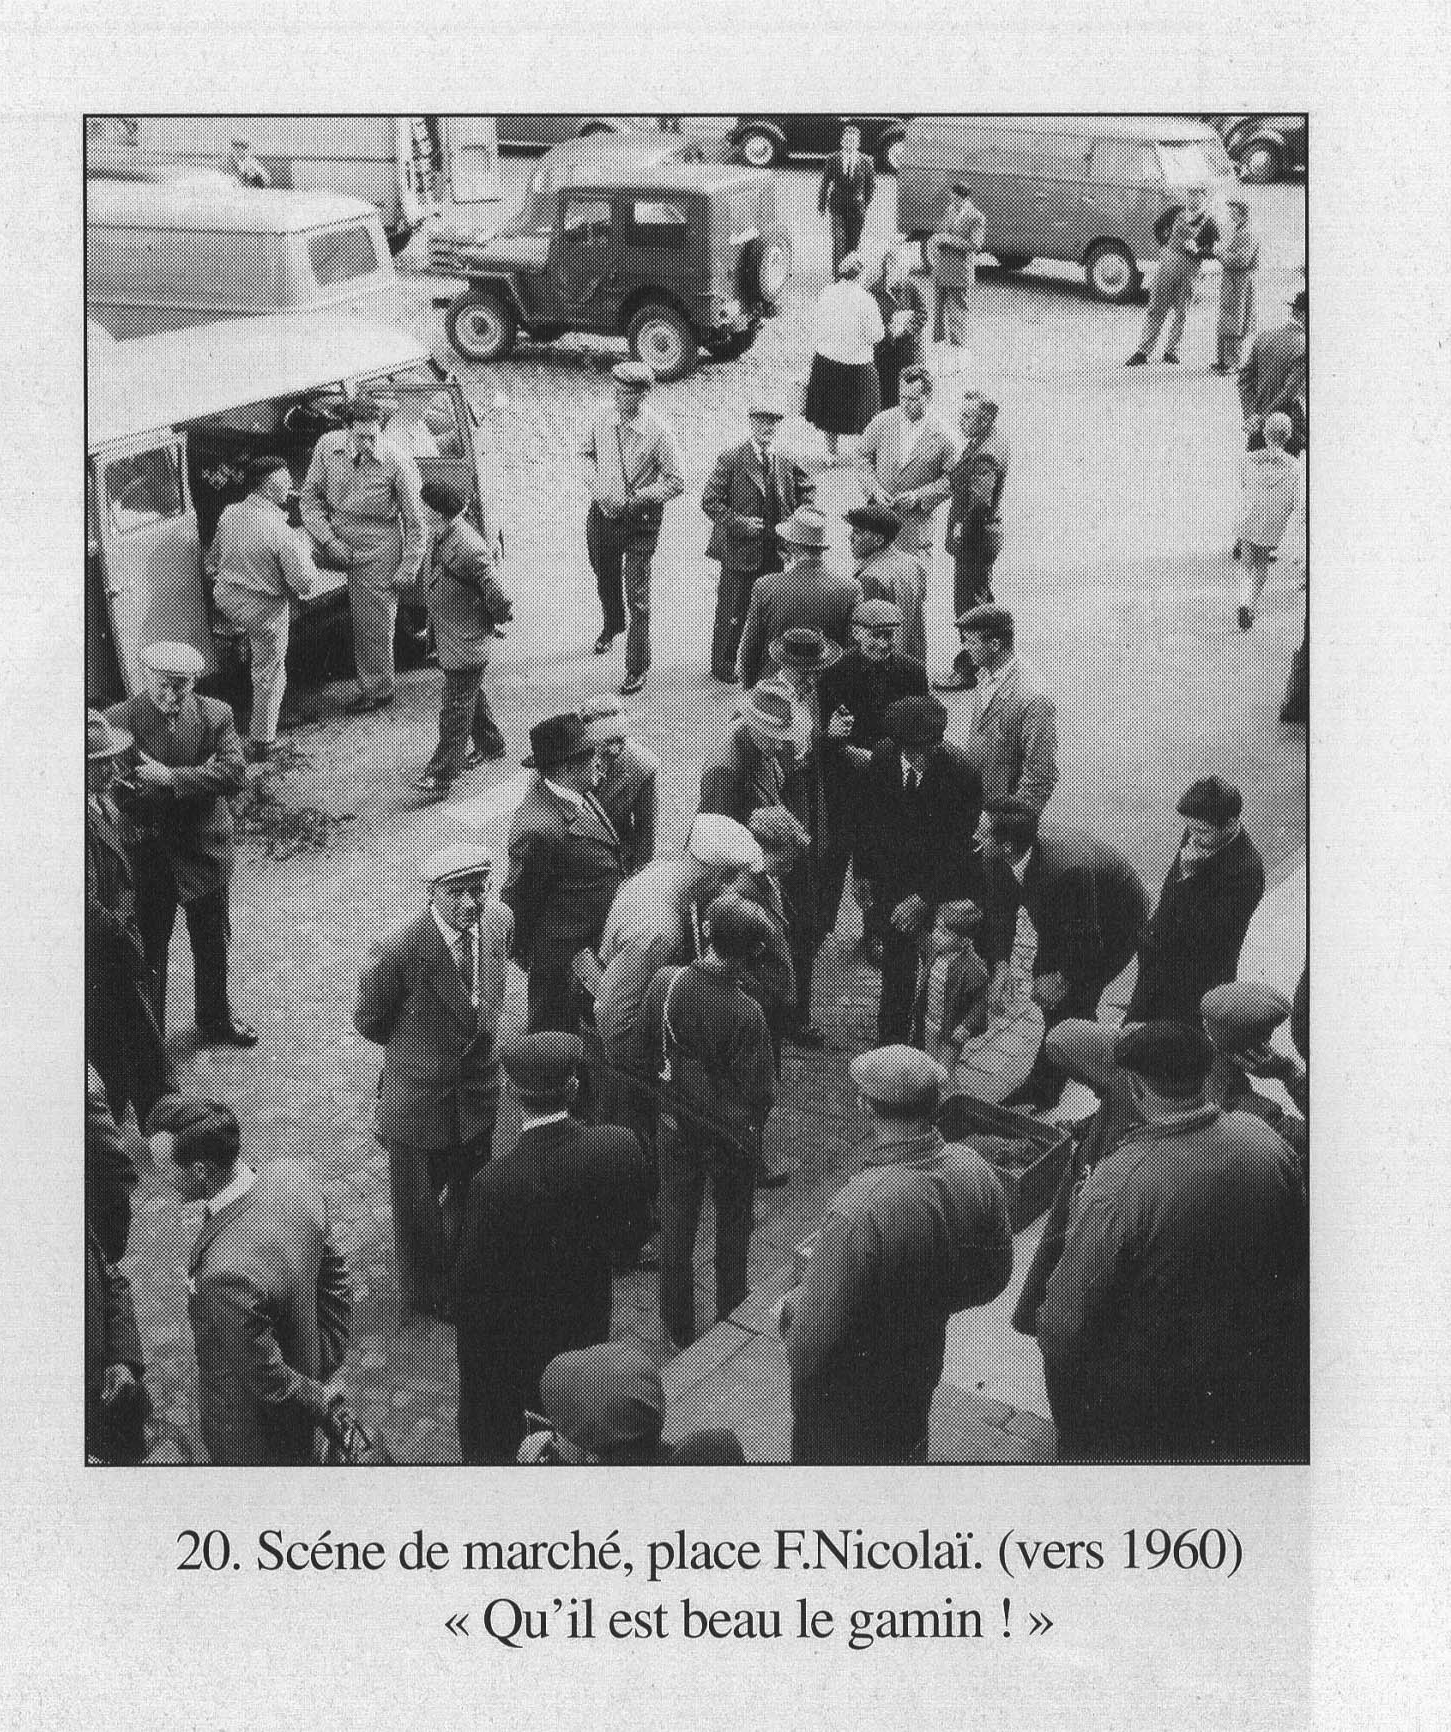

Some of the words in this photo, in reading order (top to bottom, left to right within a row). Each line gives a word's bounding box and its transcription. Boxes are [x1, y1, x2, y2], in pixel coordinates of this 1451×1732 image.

[176, 1530, 241, 1570] 20.
[257, 1530, 386, 1570] Scéne
[399, 1530, 449, 1570] de
[463, 1530, 634, 1577] marché,
[647, 1530, 761, 1582] place
[773, 1530, 983, 1570] F.Nicolaï.
[998, 1531, 1105, 1578] (vers
[1123, 1530, 1243, 1578] 1960)
[609, 1605, 669, 1639] est
[682, 1598, 782, 1639] beau
[797, 1598, 834, 1639] le
[848, 1598, 983, 1650] gamin
